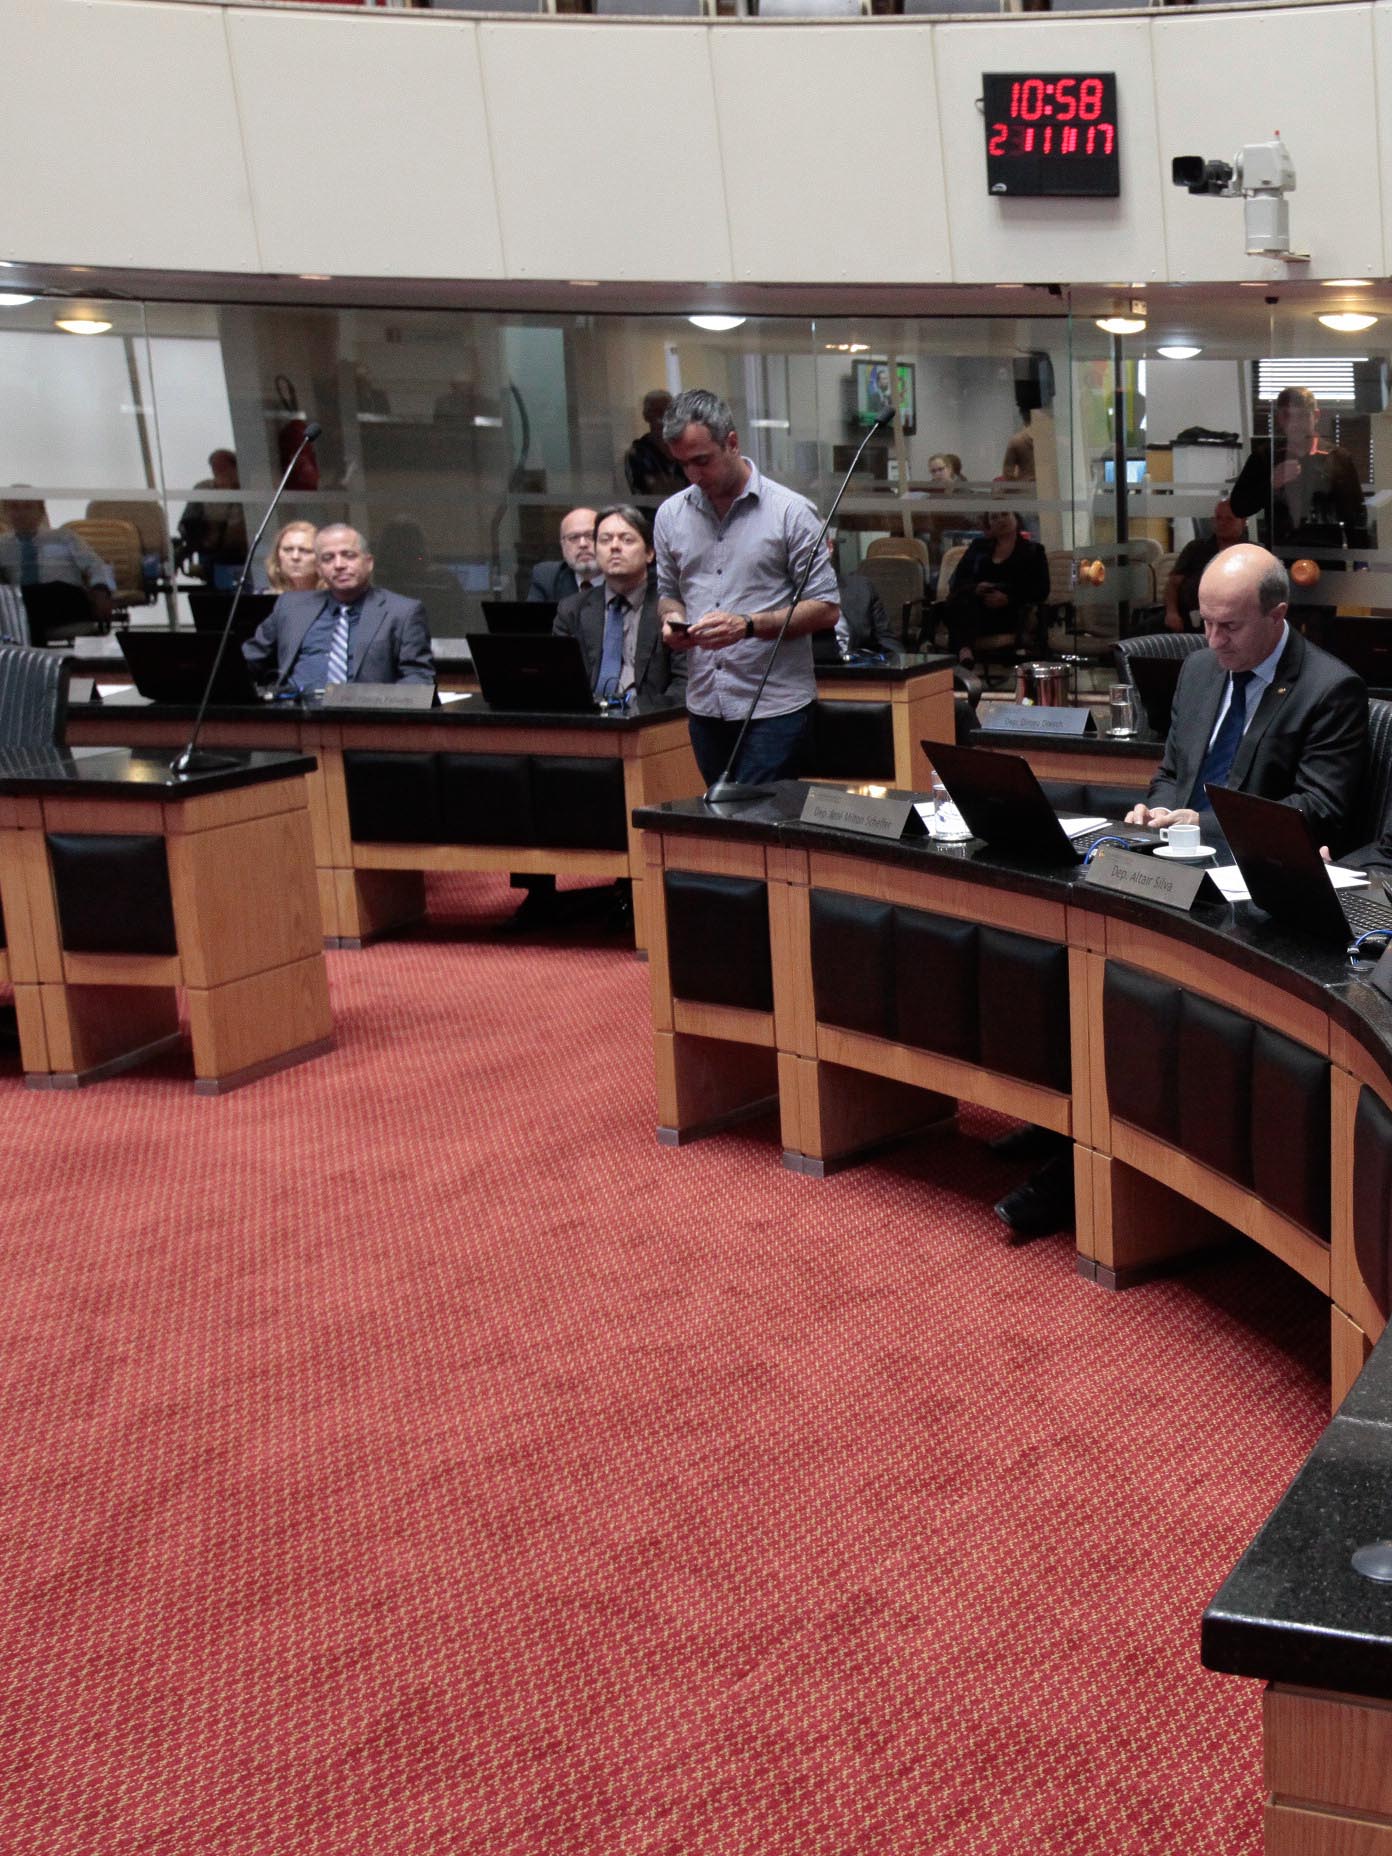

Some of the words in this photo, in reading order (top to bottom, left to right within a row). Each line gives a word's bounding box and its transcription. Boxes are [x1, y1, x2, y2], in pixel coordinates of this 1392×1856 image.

[1010, 78, 1104, 121] 10:58
[1111, 865, 1128, 882] Dep.
[1130, 872, 1152, 886] Altair
[1153, 877, 1174, 892] Silva
